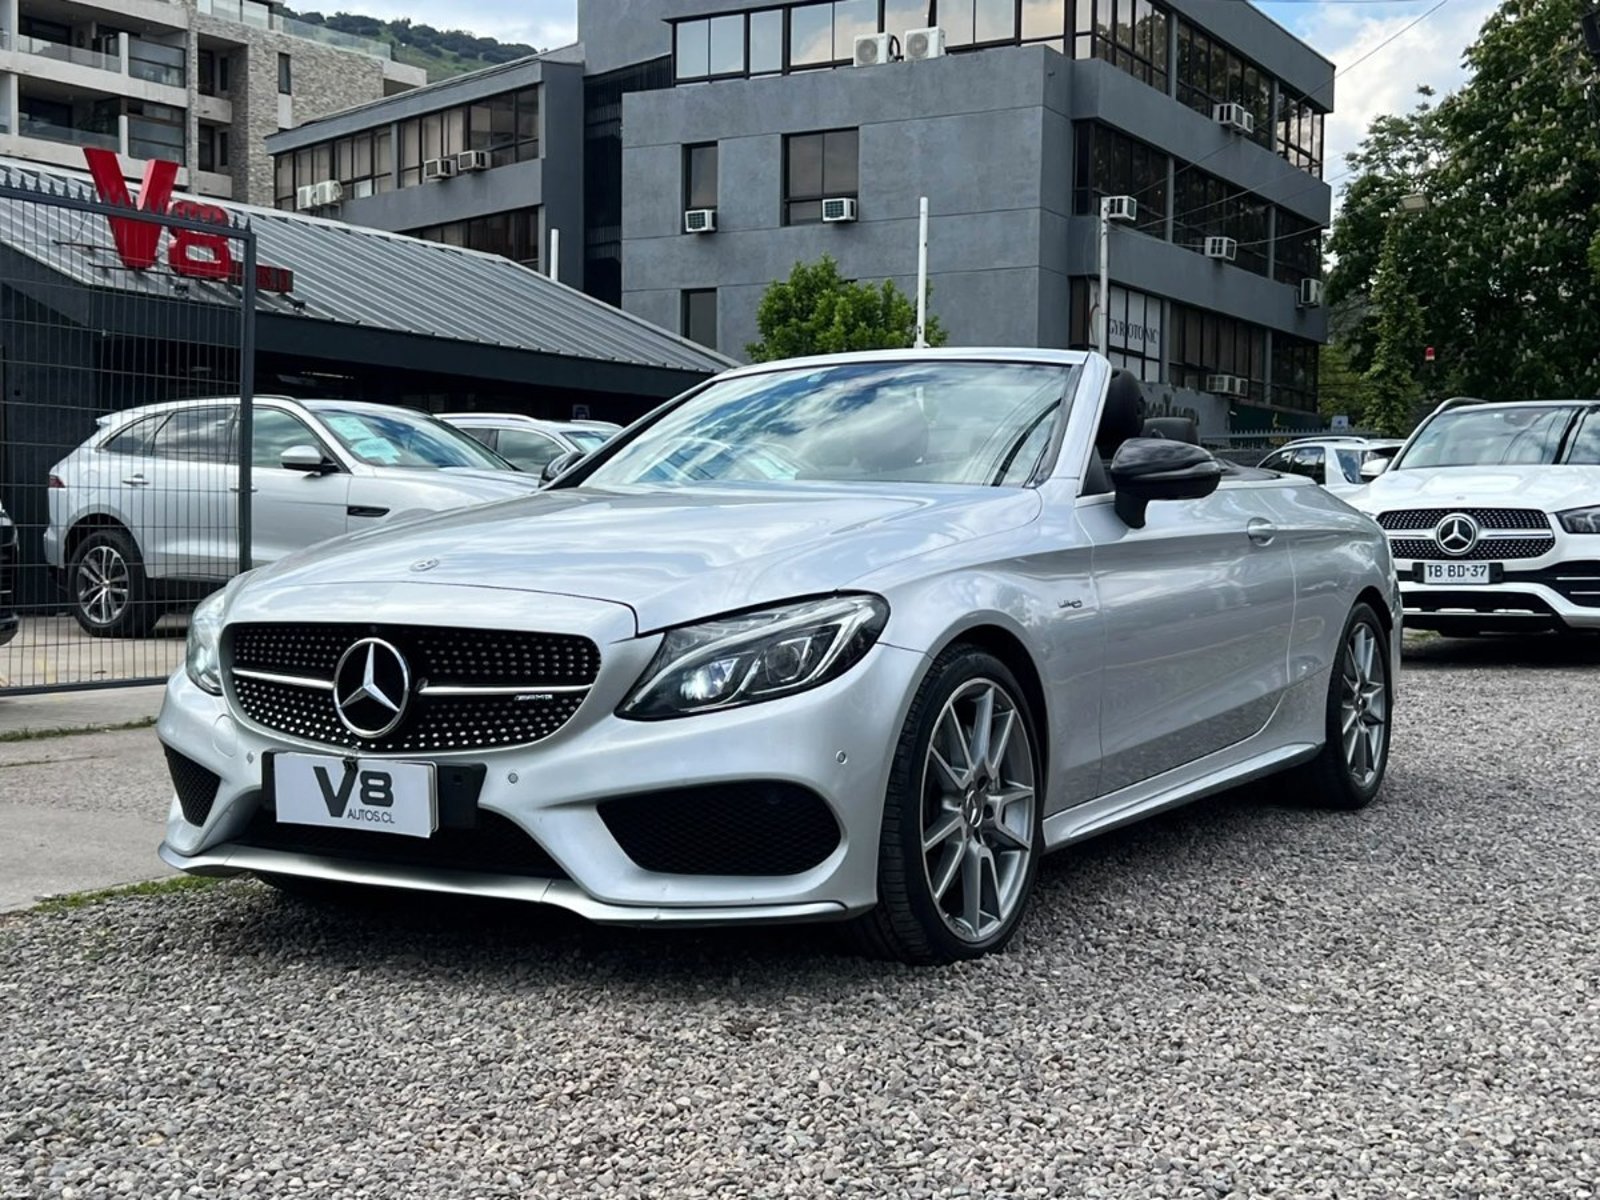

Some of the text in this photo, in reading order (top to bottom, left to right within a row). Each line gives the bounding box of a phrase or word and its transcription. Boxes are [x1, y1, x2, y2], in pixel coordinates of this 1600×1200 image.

[83, 147, 232, 279] V8
[313, 766, 394, 818] V8
[347, 808, 395, 824] AUTOS.CL
